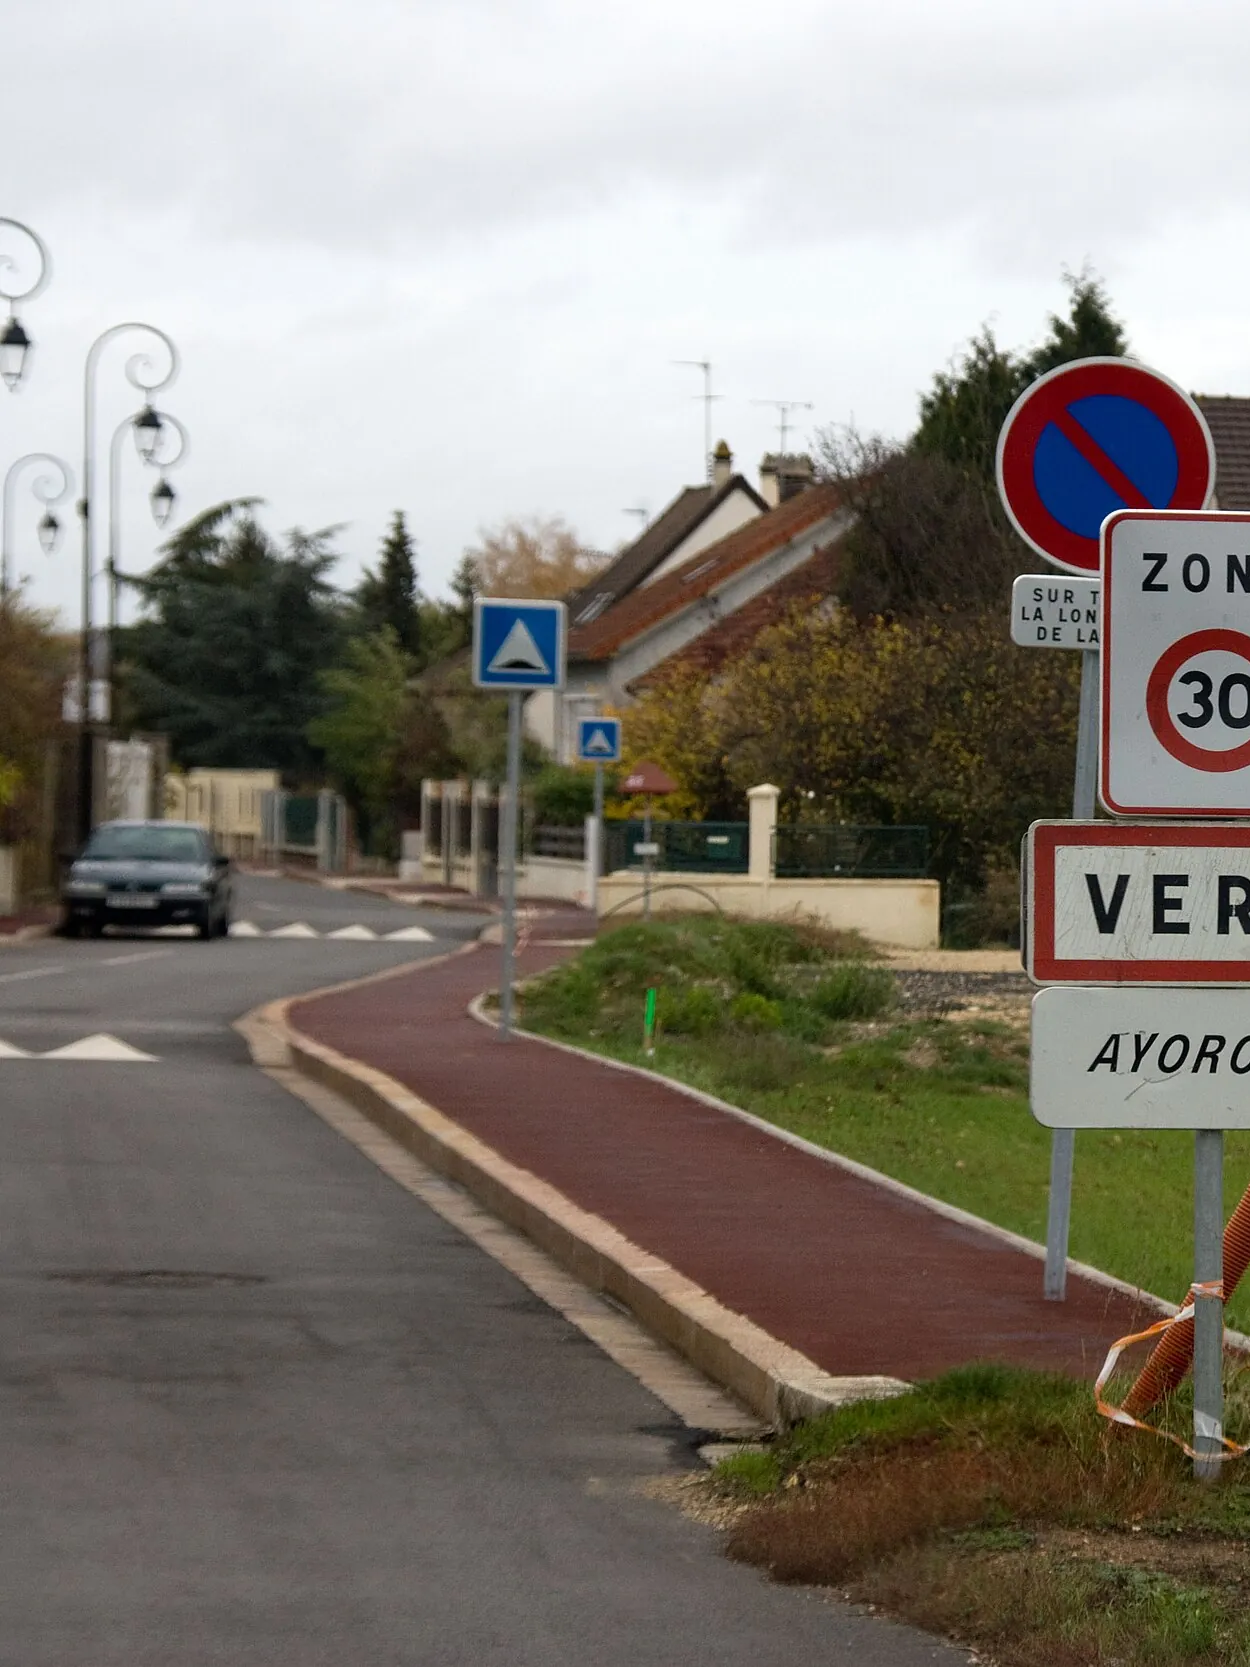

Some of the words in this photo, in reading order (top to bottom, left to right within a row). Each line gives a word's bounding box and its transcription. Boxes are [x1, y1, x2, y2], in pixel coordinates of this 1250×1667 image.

[1032, 587, 1075, 604] SUR
[1090, 590, 1100, 605] T
[1021, 606, 1044, 622] LA
[1058, 607, 1098, 624] LON
[1036, 626, 1063, 642] DE
[1076, 628, 1100, 644] LA
